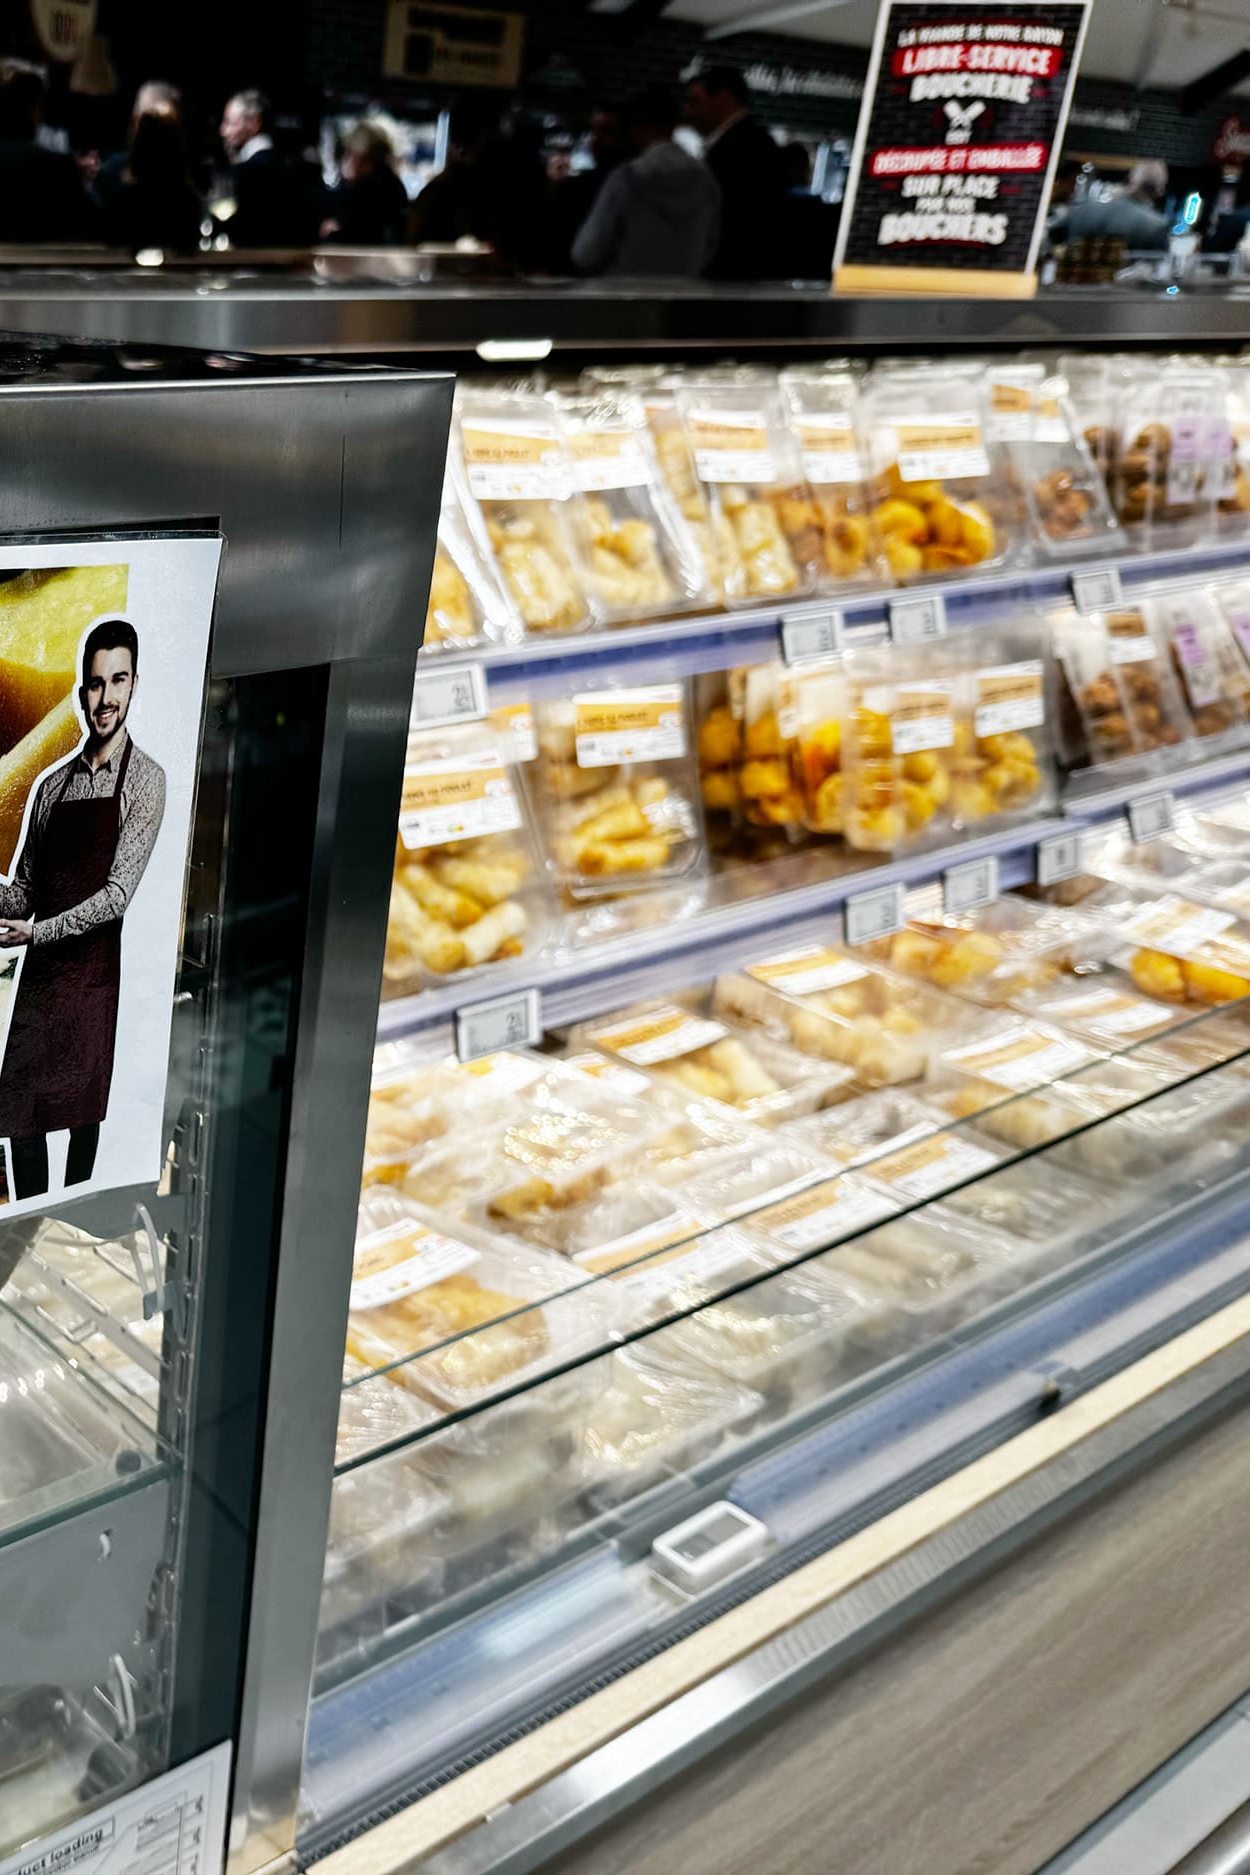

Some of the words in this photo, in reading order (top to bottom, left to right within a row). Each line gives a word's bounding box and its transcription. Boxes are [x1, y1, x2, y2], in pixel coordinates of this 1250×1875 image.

[902, 45, 1052, 74] LIBRE-SERVICE
[910, 72, 1034, 104] BOUCHERIE
[902, 175, 942, 198] SUR
[942, 174, 1000, 199] PLACE
[878, 212, 1009, 245] BOUCHERS
[50, 1829, 103, 1862] loading
